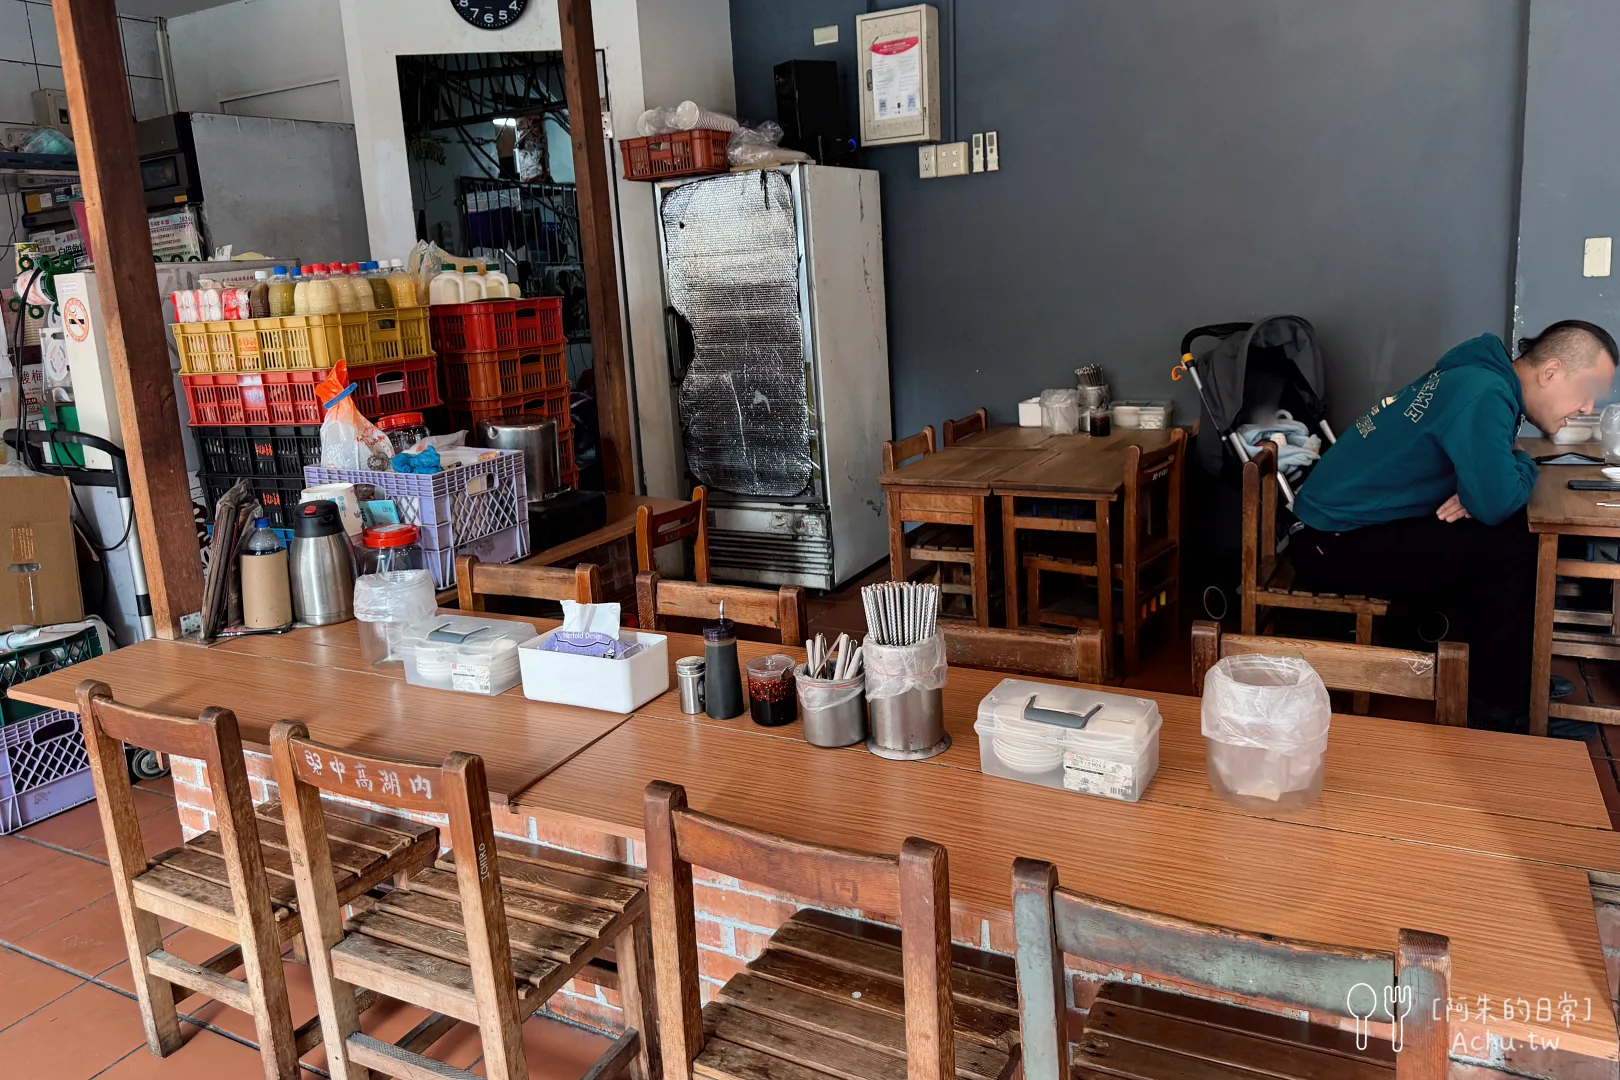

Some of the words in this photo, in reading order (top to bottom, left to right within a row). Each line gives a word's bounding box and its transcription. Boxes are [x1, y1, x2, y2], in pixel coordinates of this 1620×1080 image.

[508, 0, 518, 10] 4
[469, 8, 479, 18] 7
[483, 13, 494, 23] 6
[498, 10, 508, 20] 5
[478, 842, 490, 883] ICHIRO
